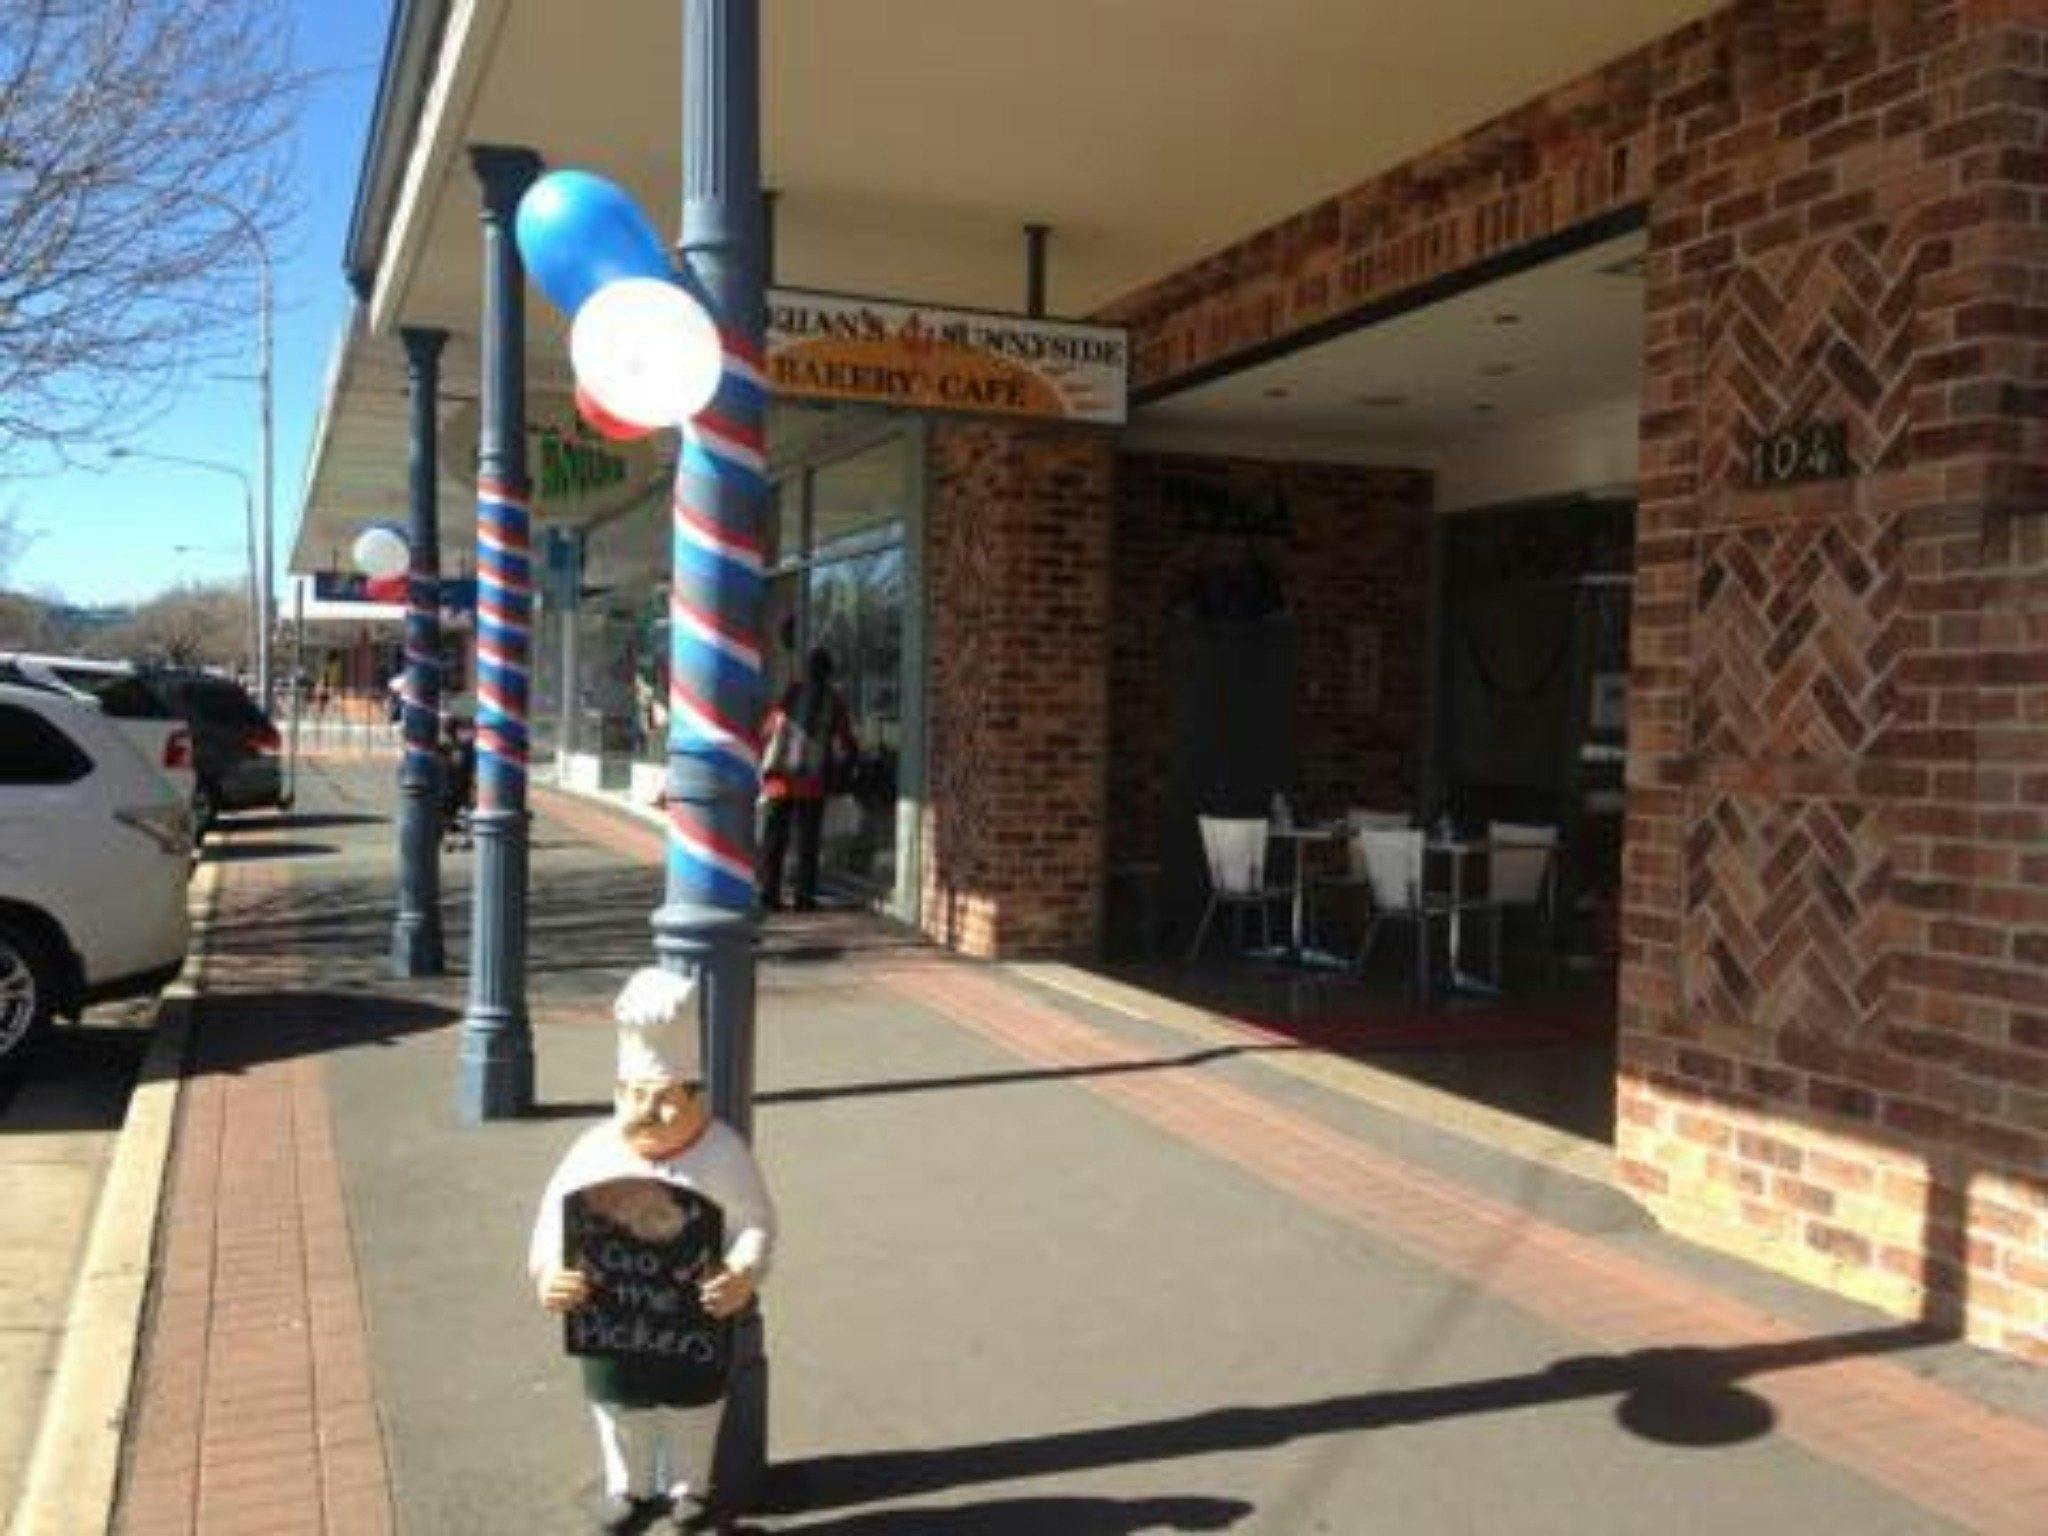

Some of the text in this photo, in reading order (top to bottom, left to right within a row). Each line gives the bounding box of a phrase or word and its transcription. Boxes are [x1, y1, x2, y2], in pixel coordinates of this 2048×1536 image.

[941, 320, 1124, 364] SUNNYSIDE
[772, 353, 914, 395] BAKERY
[602, 1242, 659, 1275] Go
